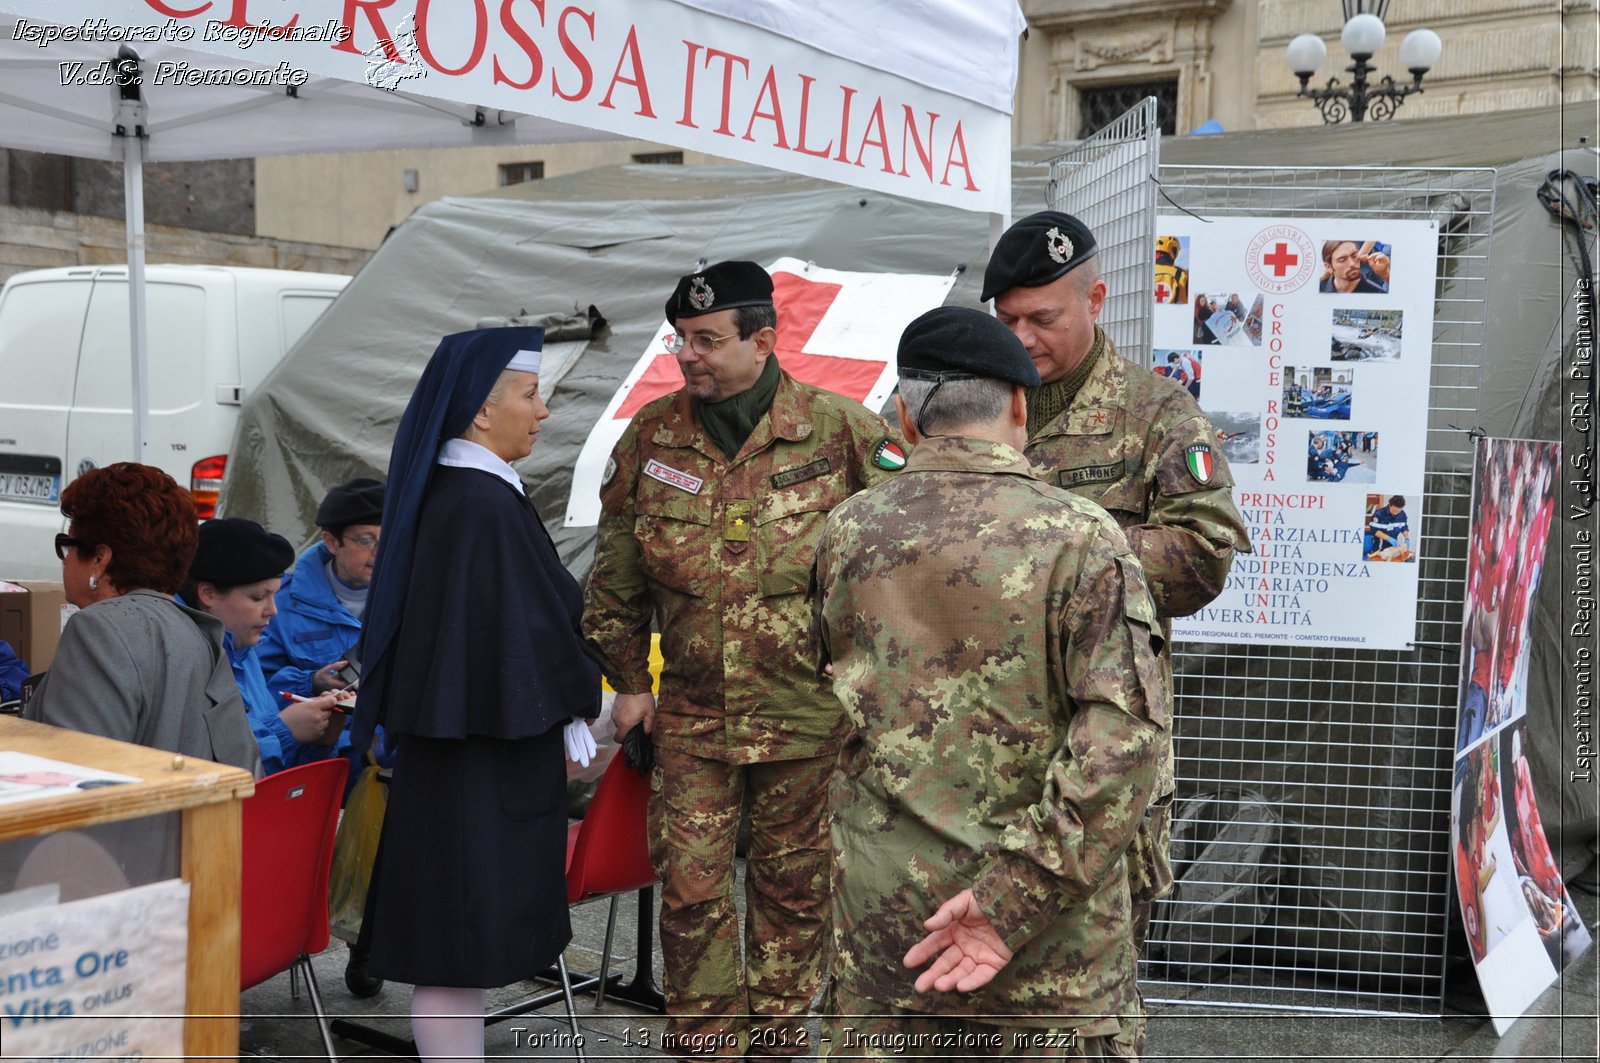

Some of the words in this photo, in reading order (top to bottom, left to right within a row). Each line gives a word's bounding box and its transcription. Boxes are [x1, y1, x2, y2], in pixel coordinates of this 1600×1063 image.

[675, 39, 981, 193] ITALIANA
[1269, 303, 1284, 386] CROCE
[875, 440, 889, 461] ITALIA
[1188, 445, 1209, 453] ITALIA
[1263, 399, 1278, 481] ROSSA
[1241, 493, 1325, 509] PRINCIPI
[1246, 527, 1362, 544] PARZIALITÁ
[1244, 592, 1301, 608] UNITÁ
[1201, 630, 1239, 638] REGIONALE
[1329, 635, 1366, 643] FEMMINILE
[74, 949, 129, 978] Ore
[3, 997, 74, 1030] Vita
[82, 982, 134, 1011] ONLUS
